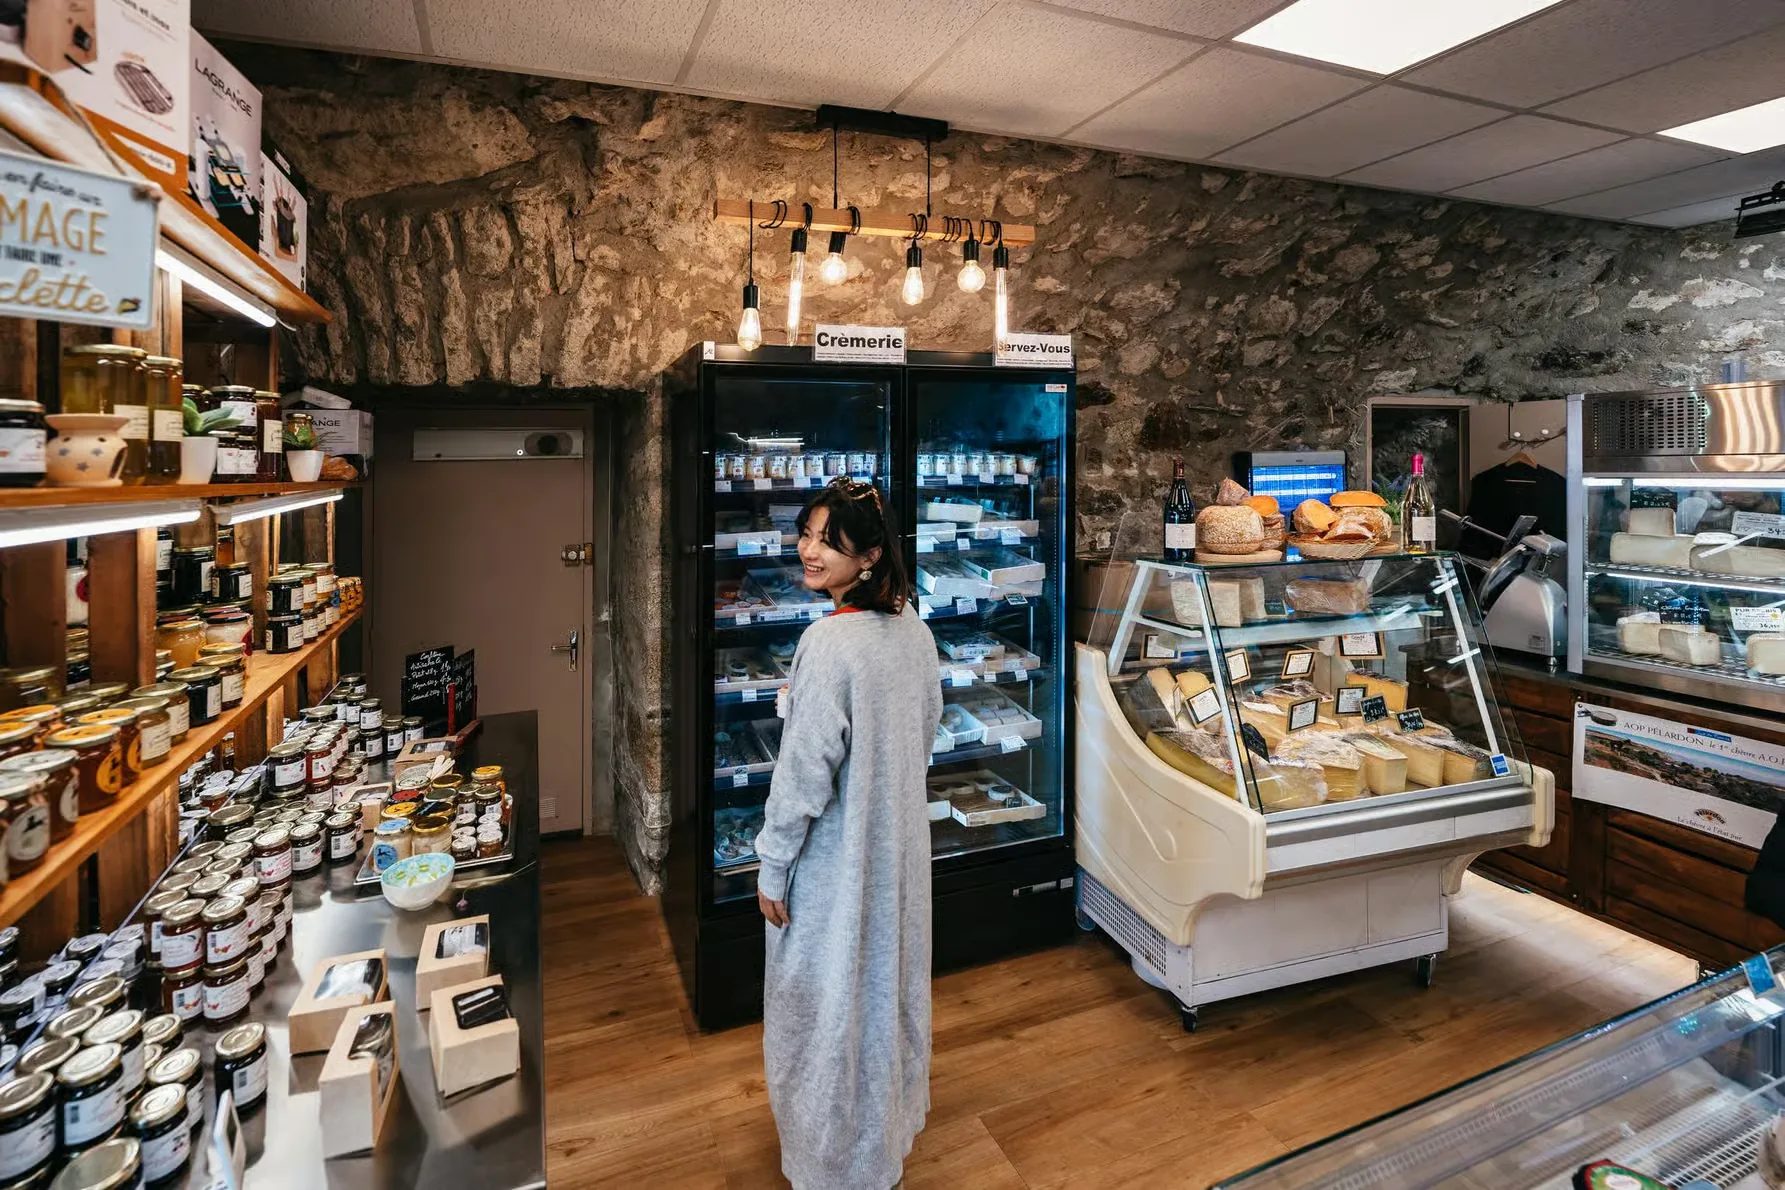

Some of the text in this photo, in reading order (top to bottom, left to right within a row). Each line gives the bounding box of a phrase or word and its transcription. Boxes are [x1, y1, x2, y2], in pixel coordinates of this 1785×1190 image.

[195, 57, 252, 118] LAGRANGE
[816, 331, 903, 349] Crèmerie
[1623, 722, 1646, 732] AOP
[1647, 725, 1705, 746] PÉLARDON
[1709, 740, 1716, 749] le
